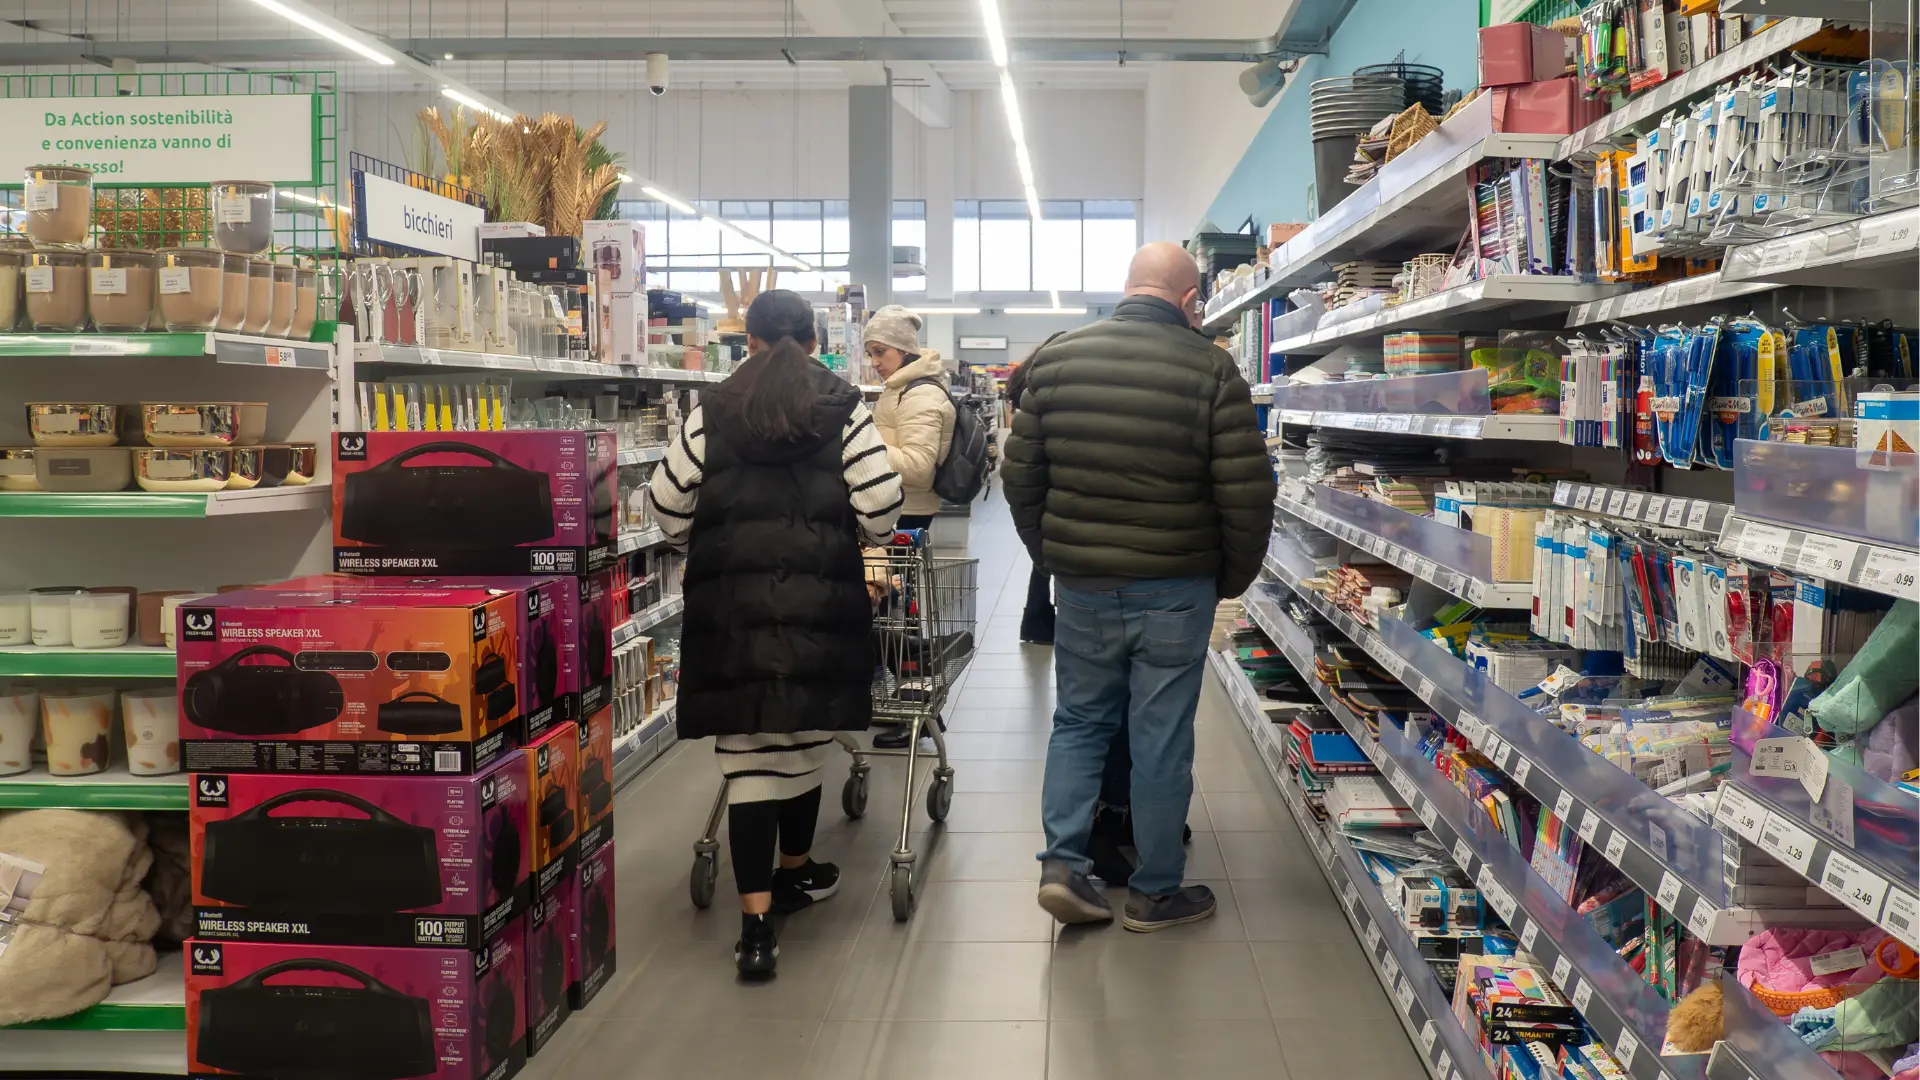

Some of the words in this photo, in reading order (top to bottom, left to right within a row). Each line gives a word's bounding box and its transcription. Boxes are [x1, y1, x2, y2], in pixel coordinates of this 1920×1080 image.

[45, 112, 66, 126] Da
[72, 111, 125, 126] Action
[130, 109, 233, 125] sostenibilità
[41, 139, 51, 150] e
[56, 135, 157, 150] convenienza
[162, 137, 212, 149] vanno
[216, 134, 232, 148] di
[403, 204, 453, 240] bicchieri
[339, 558, 380, 568] WIRELESS
[382, 558, 420, 568] SPEAKER
[421, 558, 438, 568] XXL
[532, 552, 555, 566] 100
[221, 628, 263, 638] WIRELESS
[265, 628, 304, 638] SPEAKER
[305, 628, 322, 638] XXL
[199, 919, 246, 932] WIRELESS
[247, 921, 290, 933] SPEAKER
[291, 923, 311, 934] XXL
[417, 920, 443, 936] 100
[1495, 1006, 1512, 1018] 24
[1493, 1030, 1511, 1042] 24
